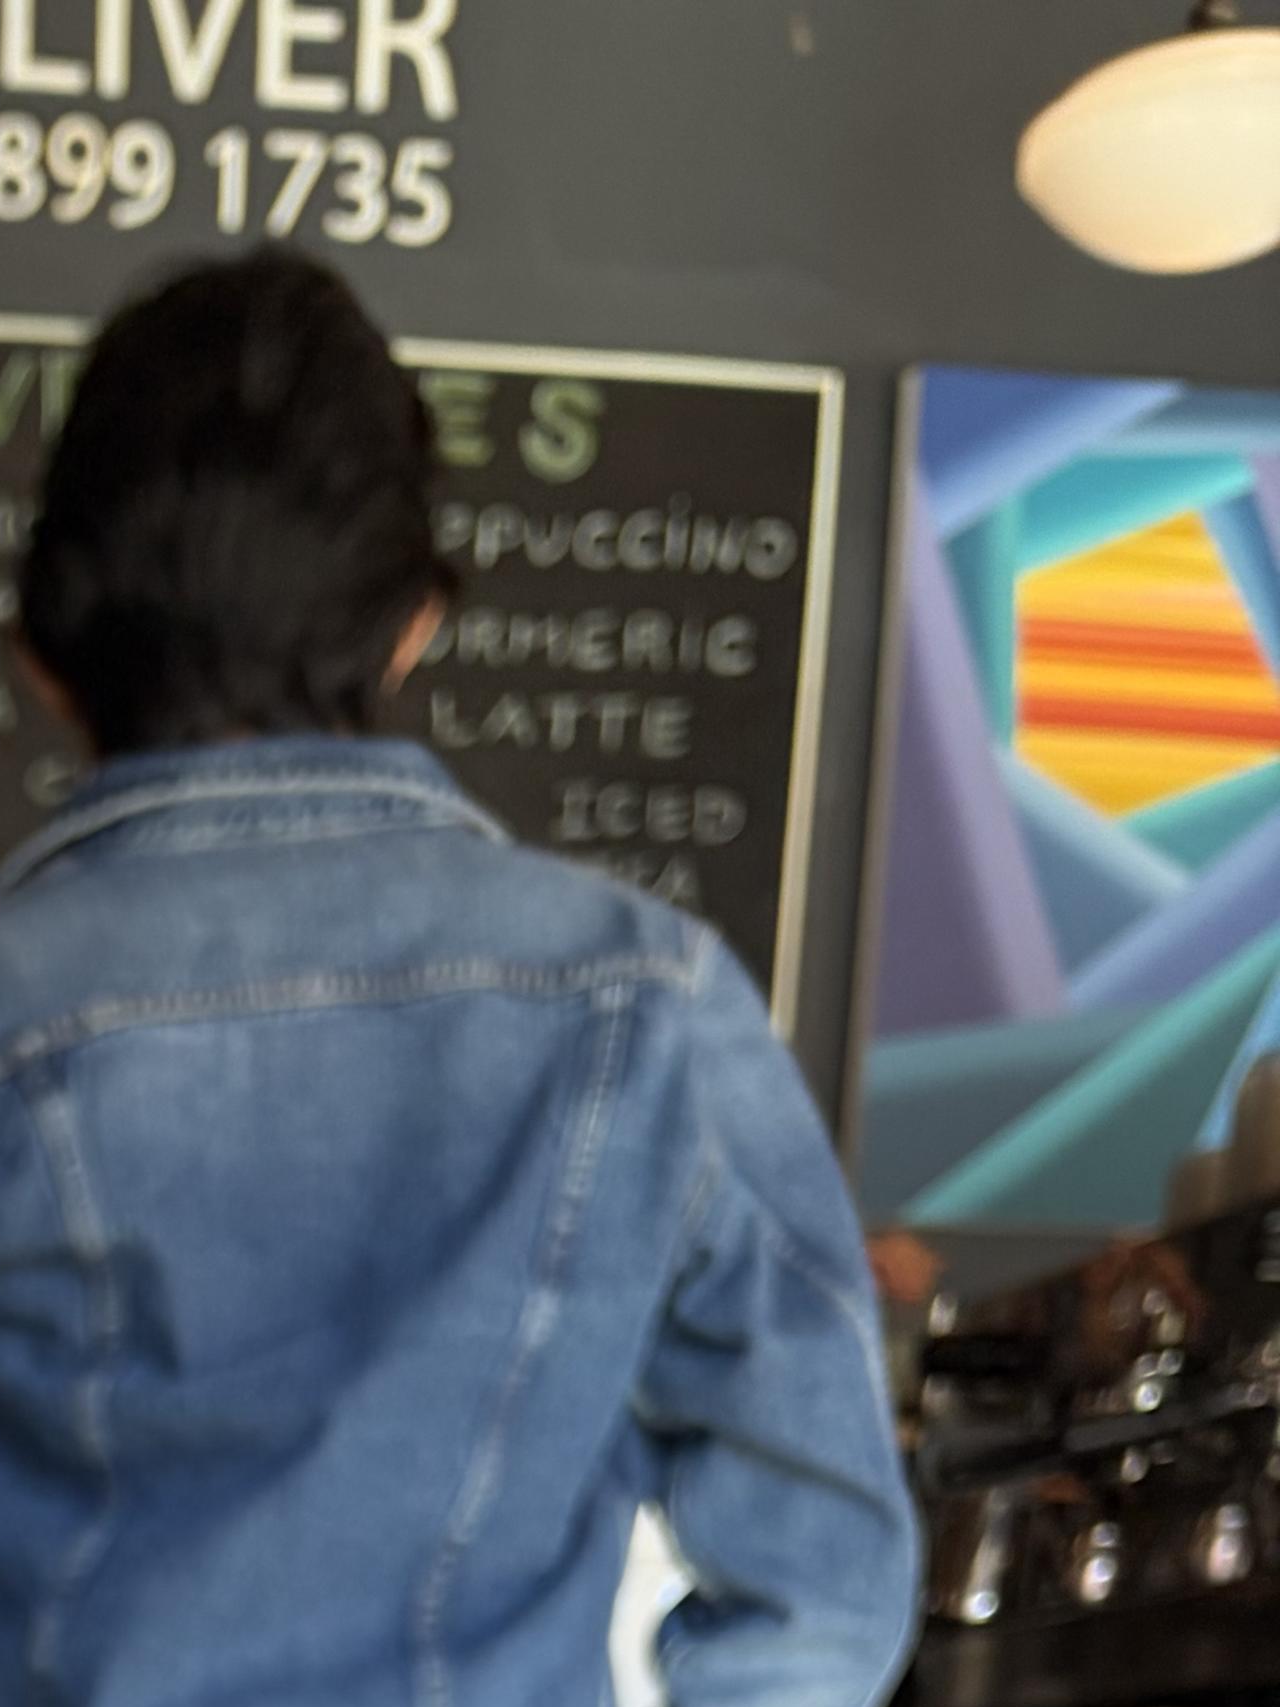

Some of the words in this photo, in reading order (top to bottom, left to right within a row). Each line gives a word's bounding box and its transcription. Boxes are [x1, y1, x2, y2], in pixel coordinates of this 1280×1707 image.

[204, 126, 454, 247] 1735
[430, 690, 694, 762] LATTE
[546, 776, 748, 848] ICED
